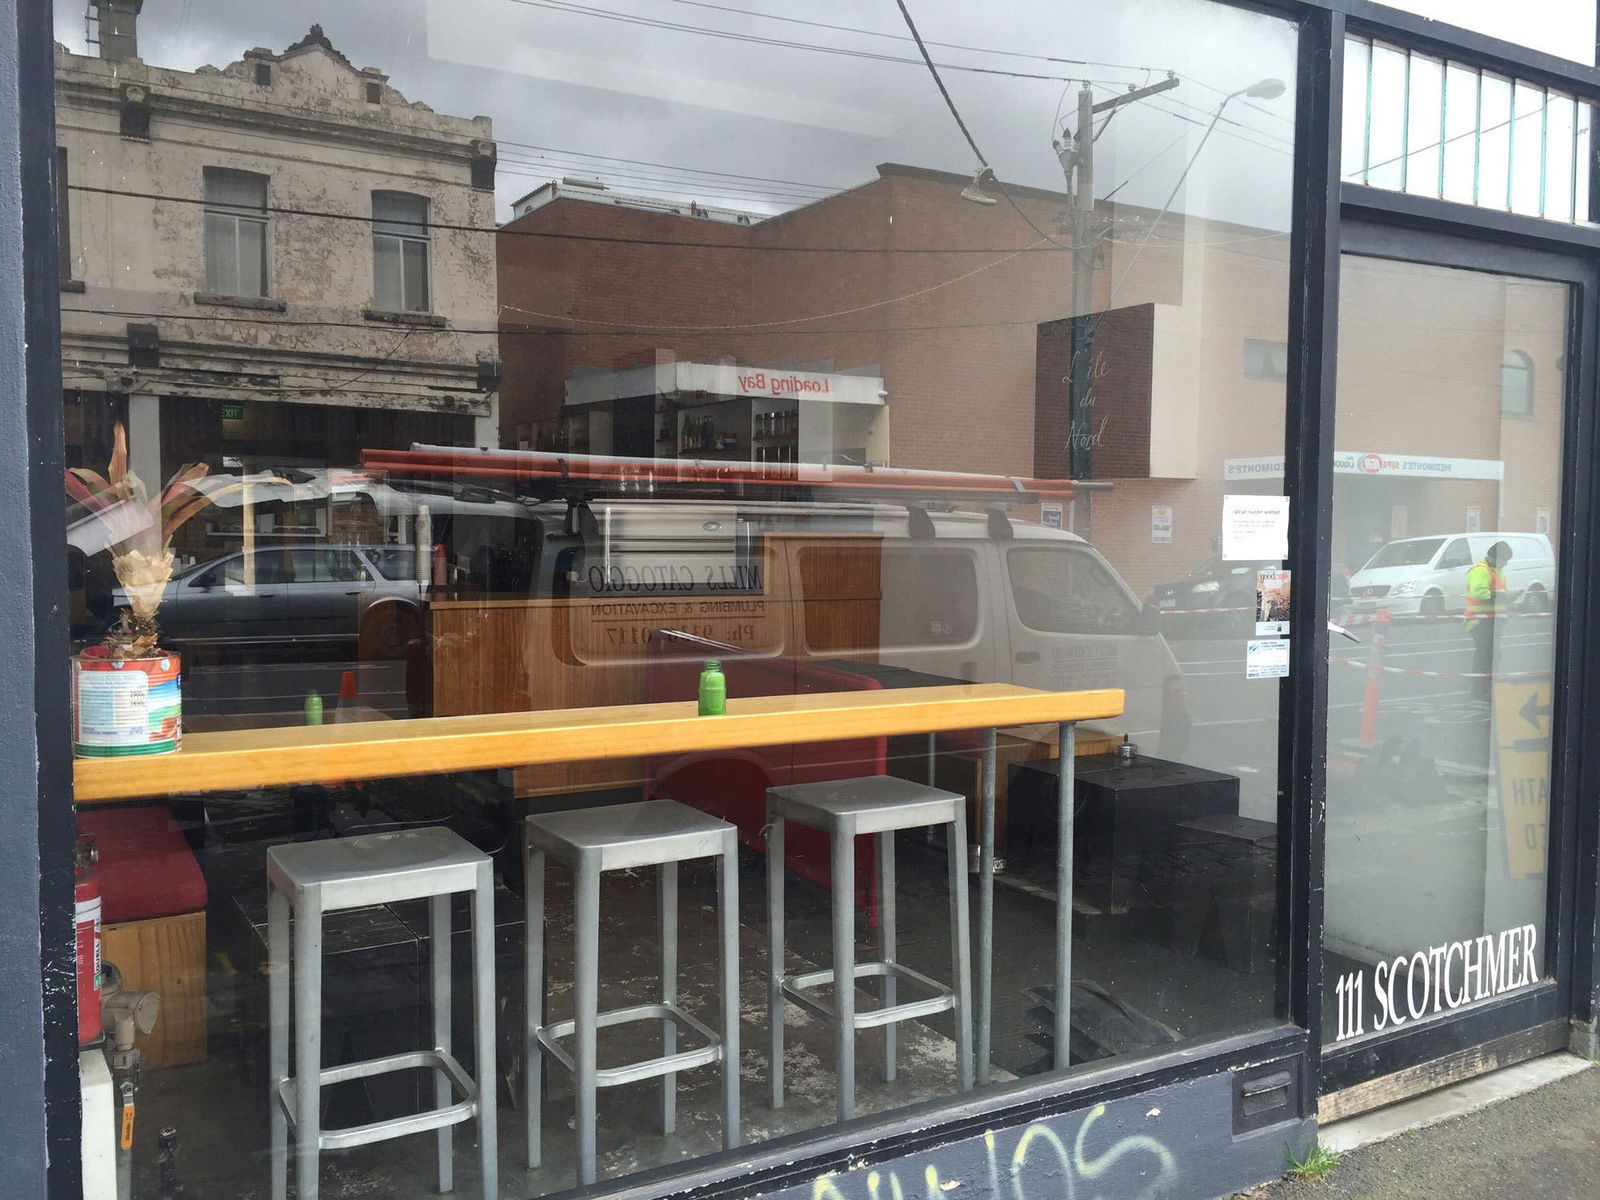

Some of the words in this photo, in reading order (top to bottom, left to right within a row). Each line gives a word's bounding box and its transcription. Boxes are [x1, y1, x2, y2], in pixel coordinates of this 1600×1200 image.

[1079, 387, 1096, 408] du
[1064, 415, 1108, 451] Nord
[1335, 969, 1364, 1042] 111
[1373, 923, 1539, 1031] SCOTCHMER
